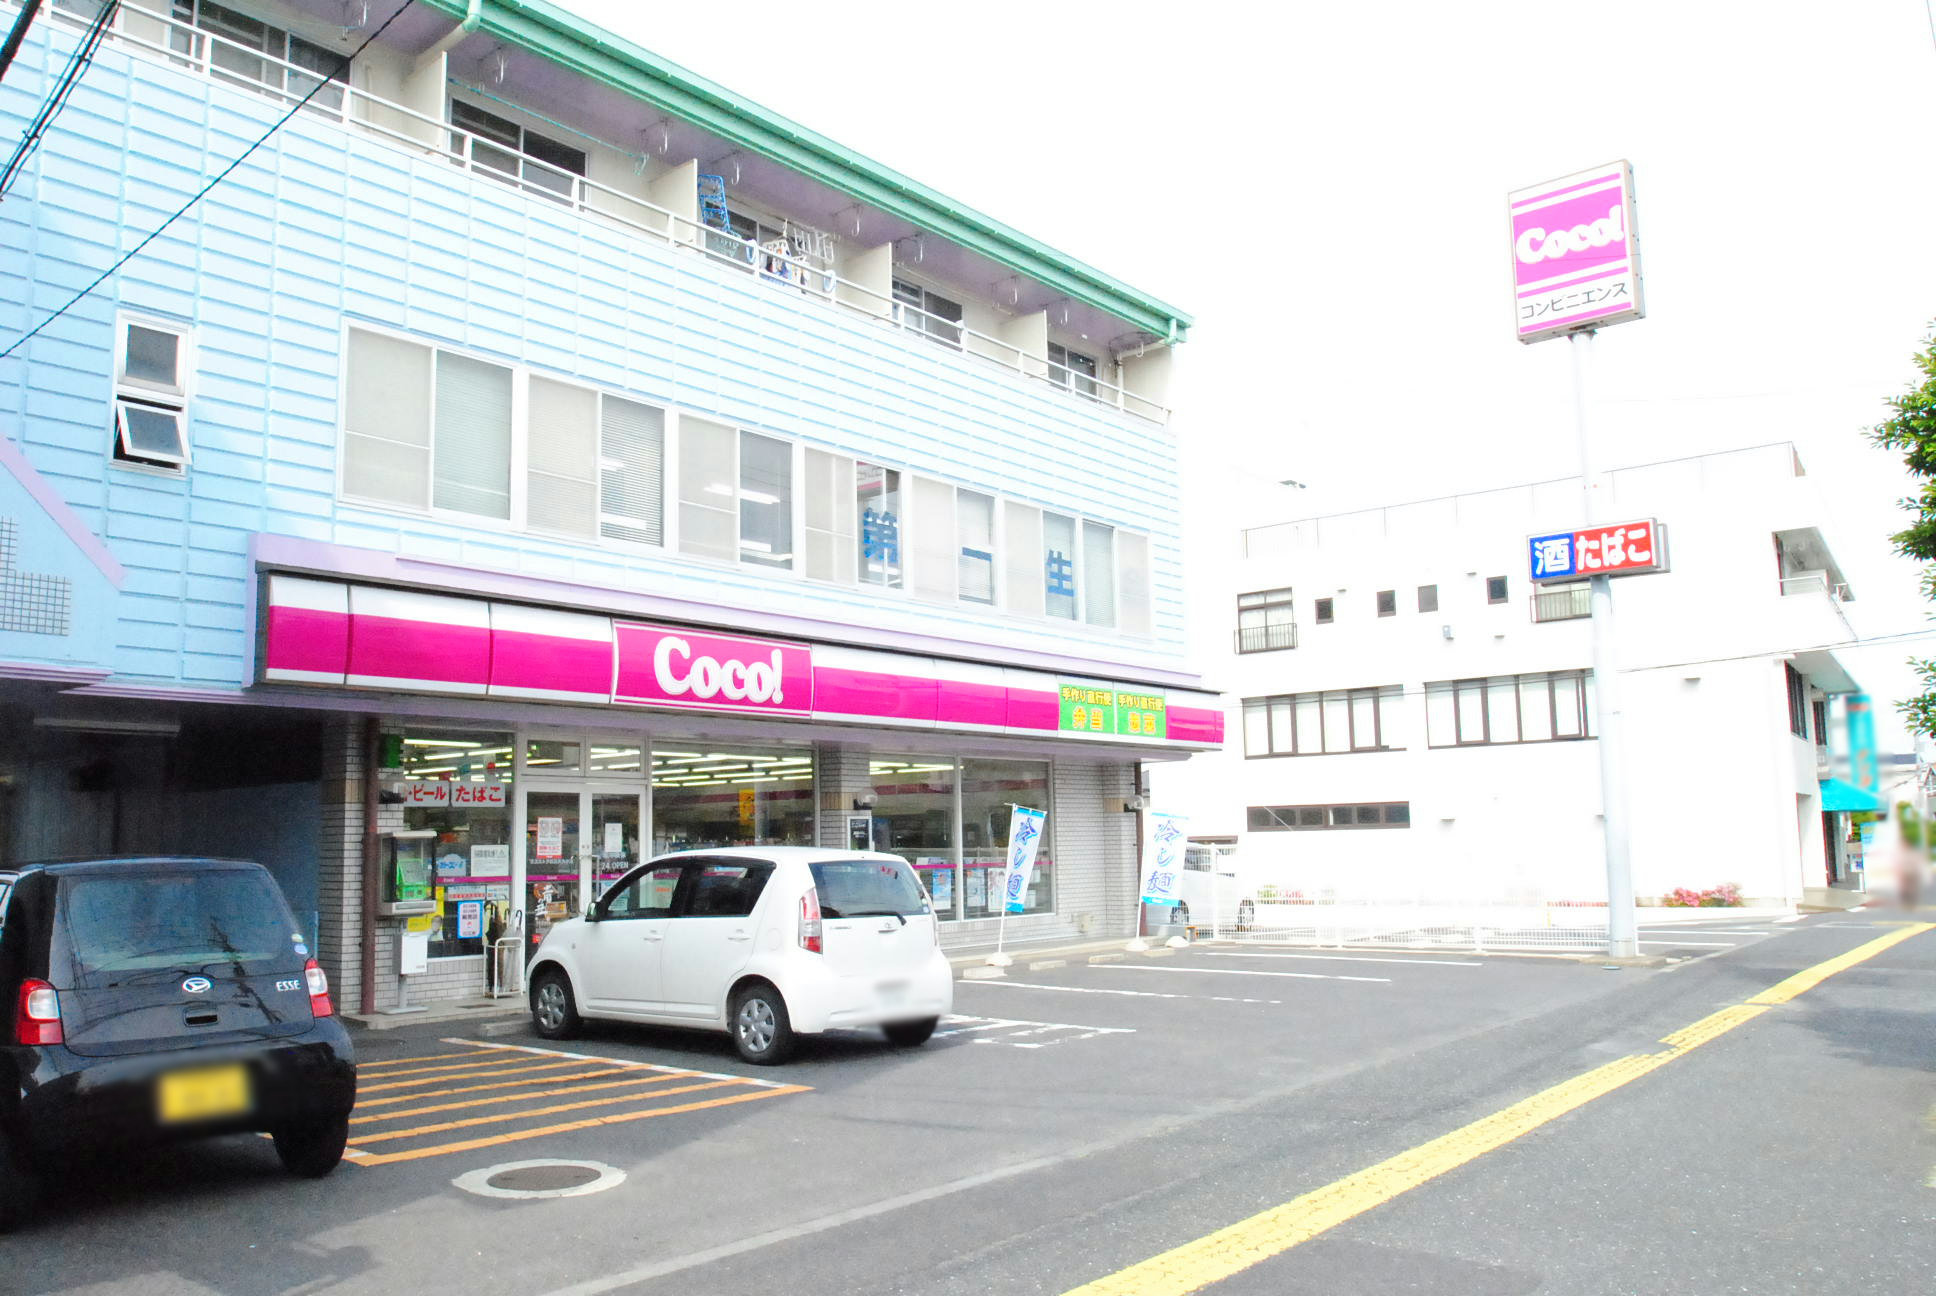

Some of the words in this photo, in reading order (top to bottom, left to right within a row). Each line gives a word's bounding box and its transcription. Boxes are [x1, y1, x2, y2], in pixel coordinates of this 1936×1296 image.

[1515, 204, 1625, 264] Coco!
[1521, 282, 1629, 320] コンビニエンス
[1534, 537, 1571, 576] 酒
[1576, 528, 1651, 571] たばこ
[653, 635, 785, 705] Coco!
[454, 785, 503, 802] たばこ
[611, 861, 629, 869] OPEN
[276, 980, 301, 991] ESSE
